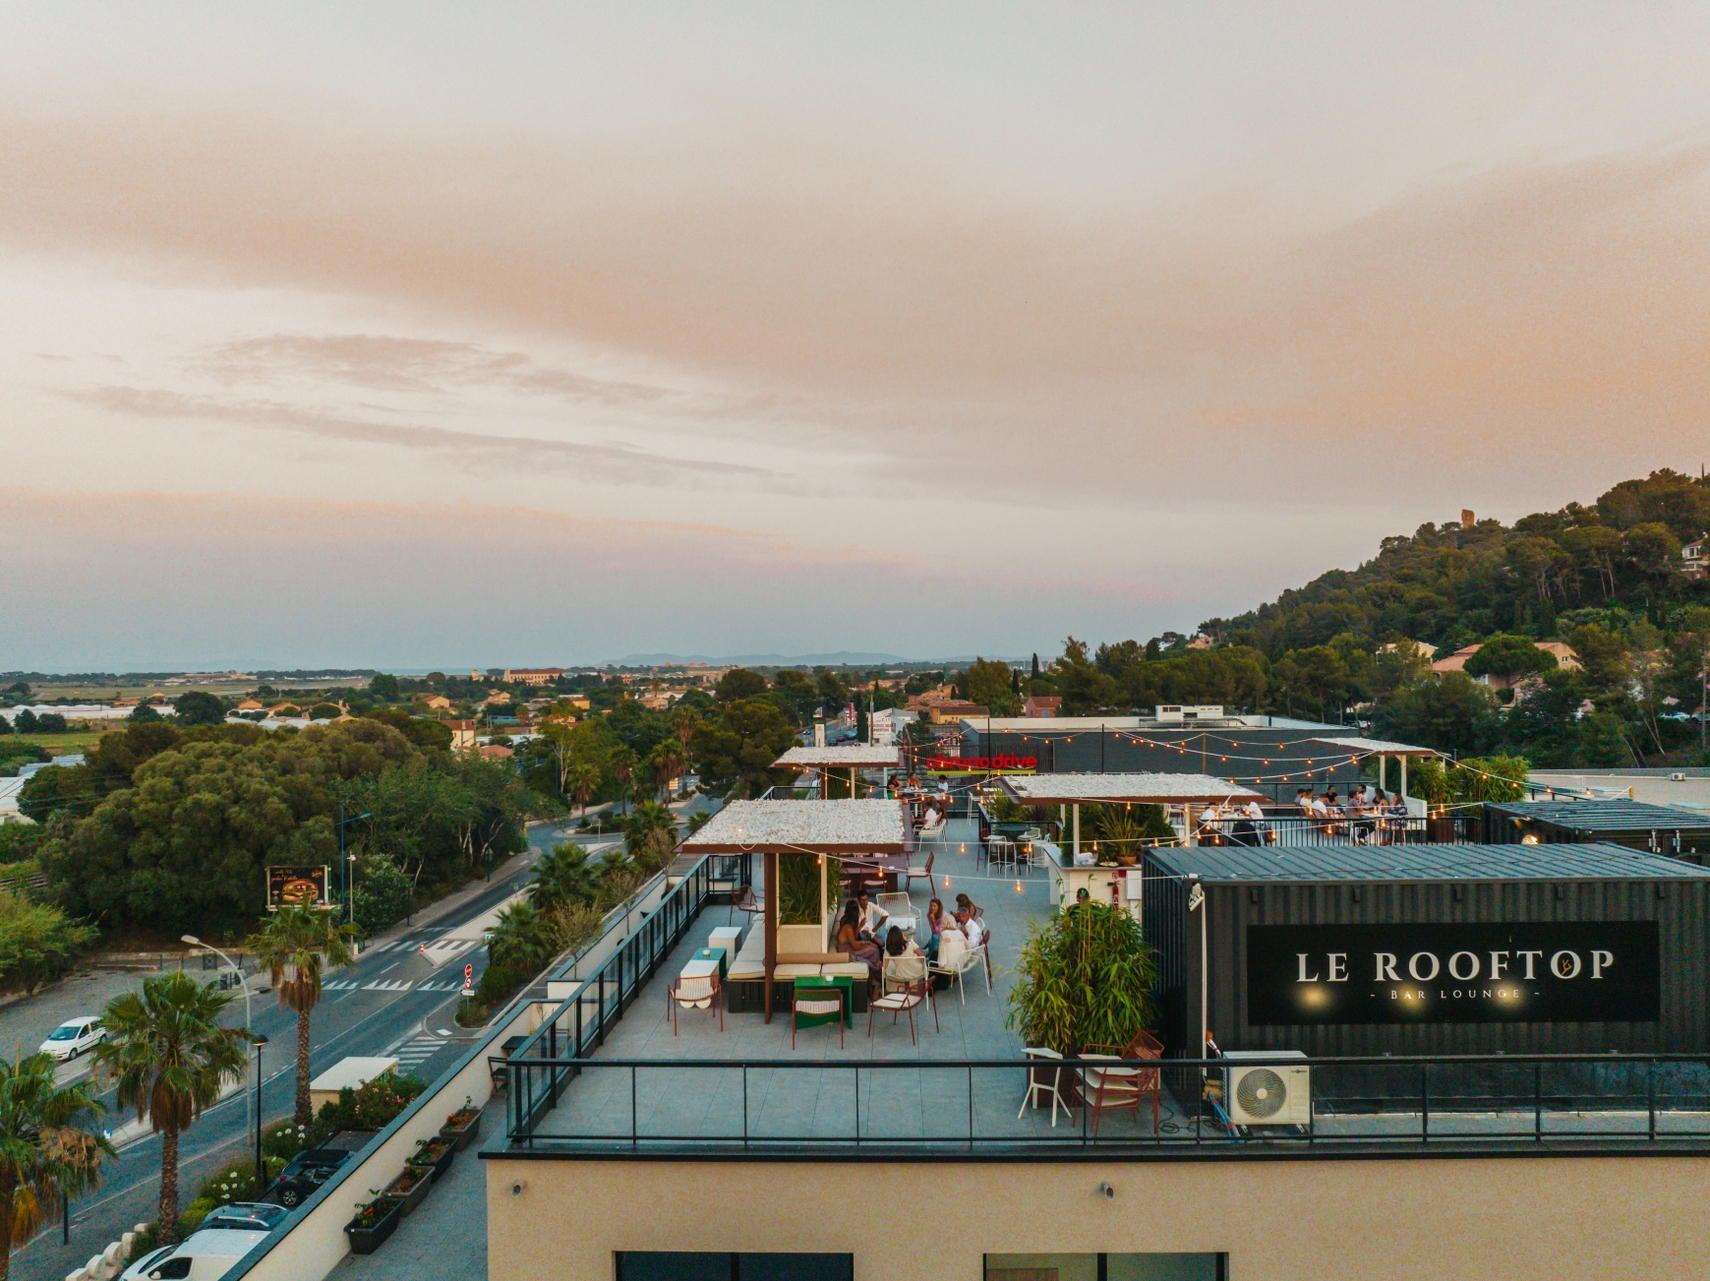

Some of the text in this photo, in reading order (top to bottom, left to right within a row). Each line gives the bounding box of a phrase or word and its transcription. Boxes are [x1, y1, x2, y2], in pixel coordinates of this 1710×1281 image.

[926, 752, 1037, 769] chronodrive
[1296, 950, 1613, 982] LE ROOFTOP
[1391, 988, 1520, 1000] BAR LOUNGE
